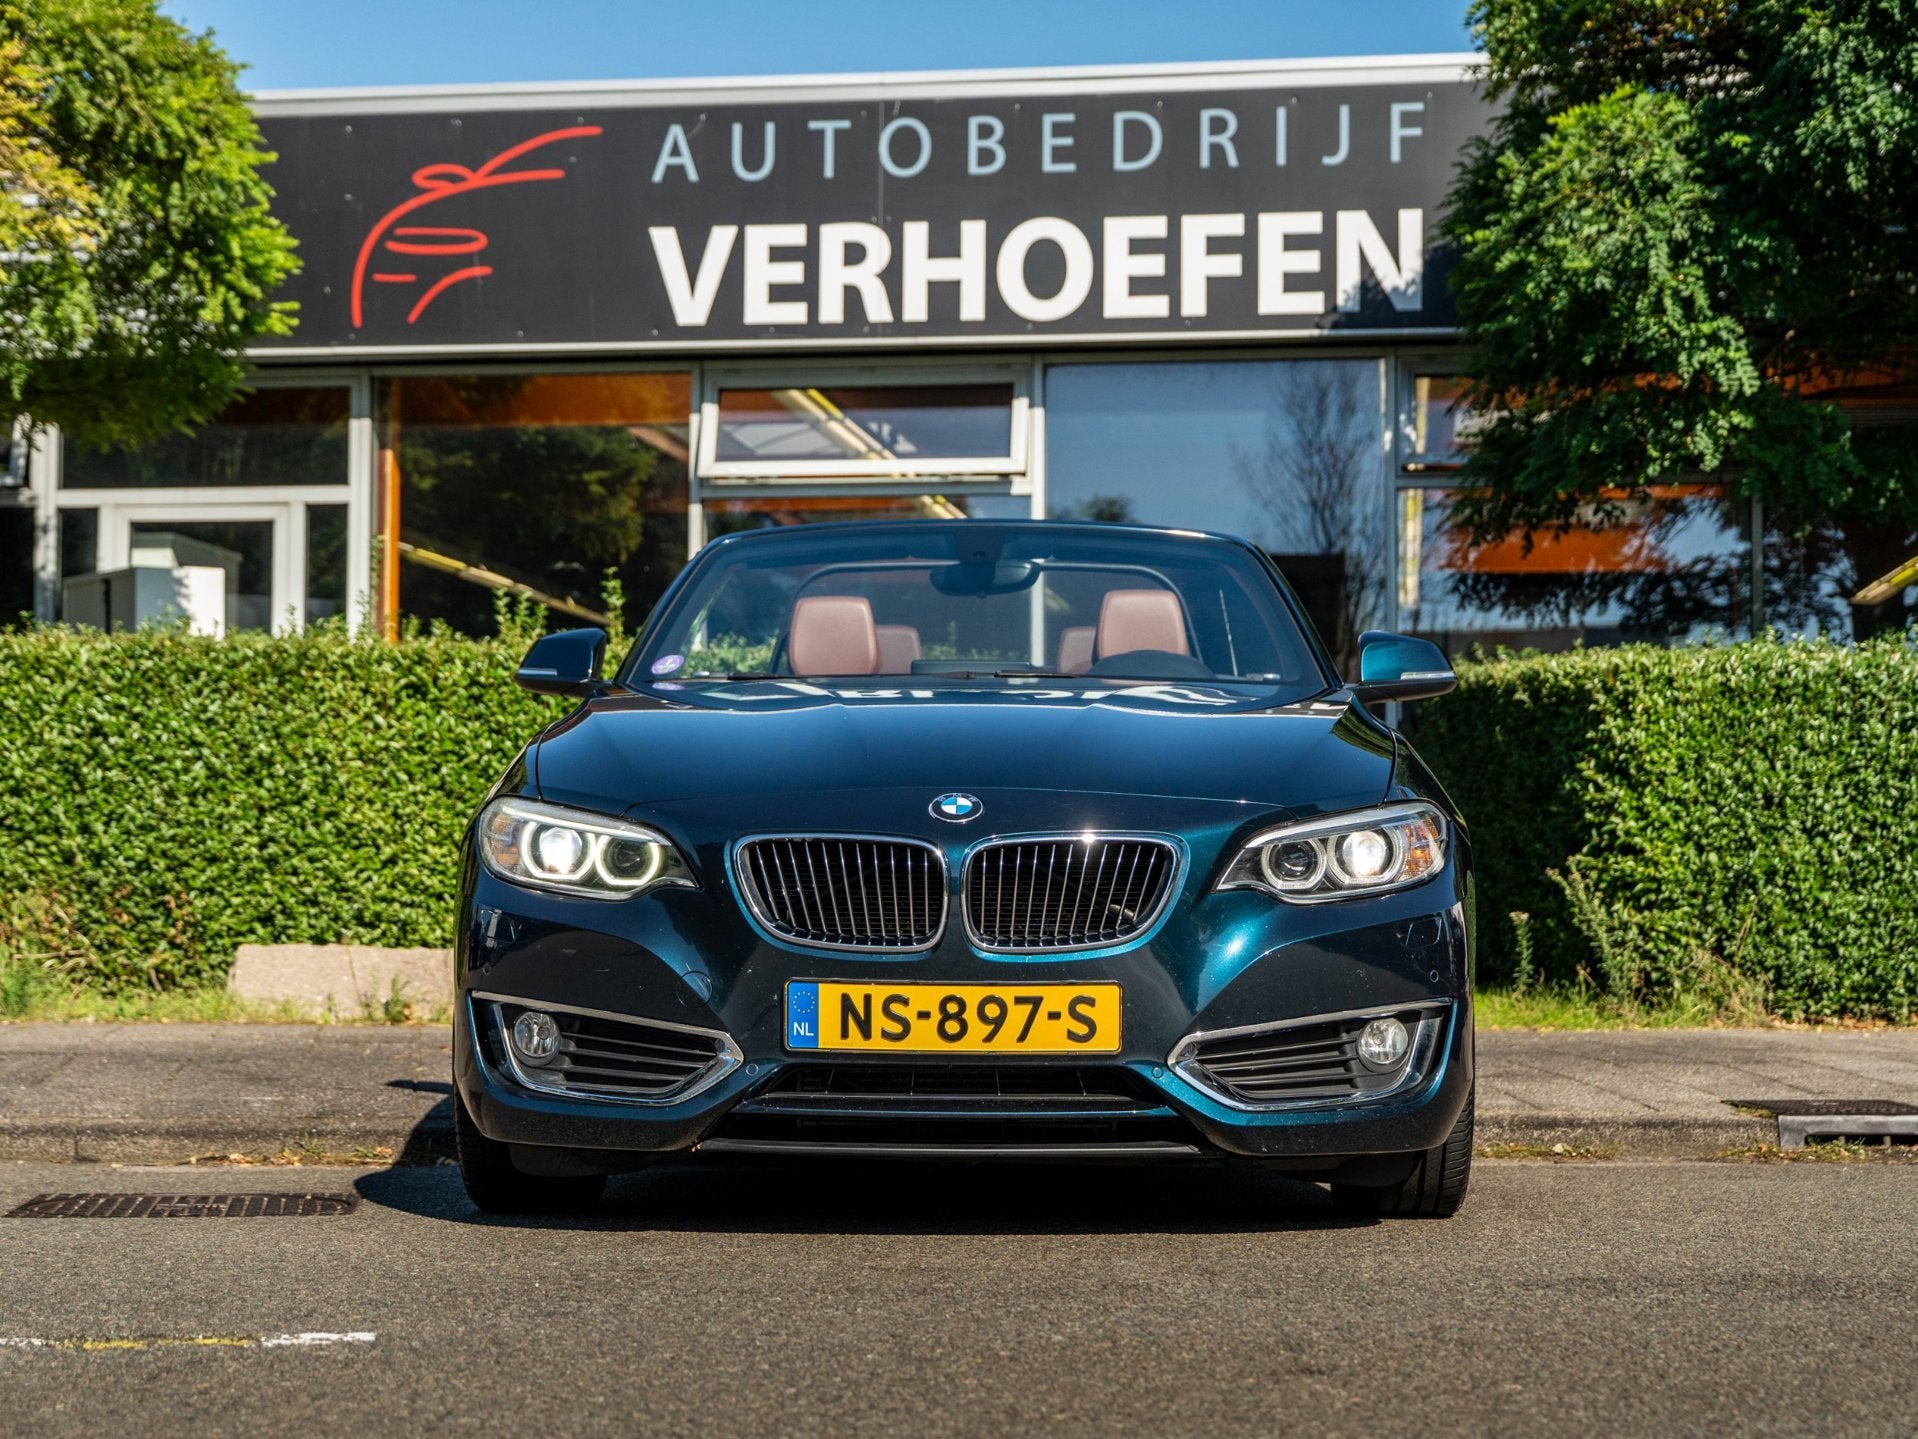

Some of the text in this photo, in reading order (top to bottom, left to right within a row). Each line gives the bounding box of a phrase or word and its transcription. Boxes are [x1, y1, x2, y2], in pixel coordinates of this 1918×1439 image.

[651, 101, 1426, 184] AUTOBEDRIJF
[648, 208, 1424, 327] VERHOEFEN
[793, 1021, 814, 1036] NL
[840, 992, 1097, 1043] NS-897-S
